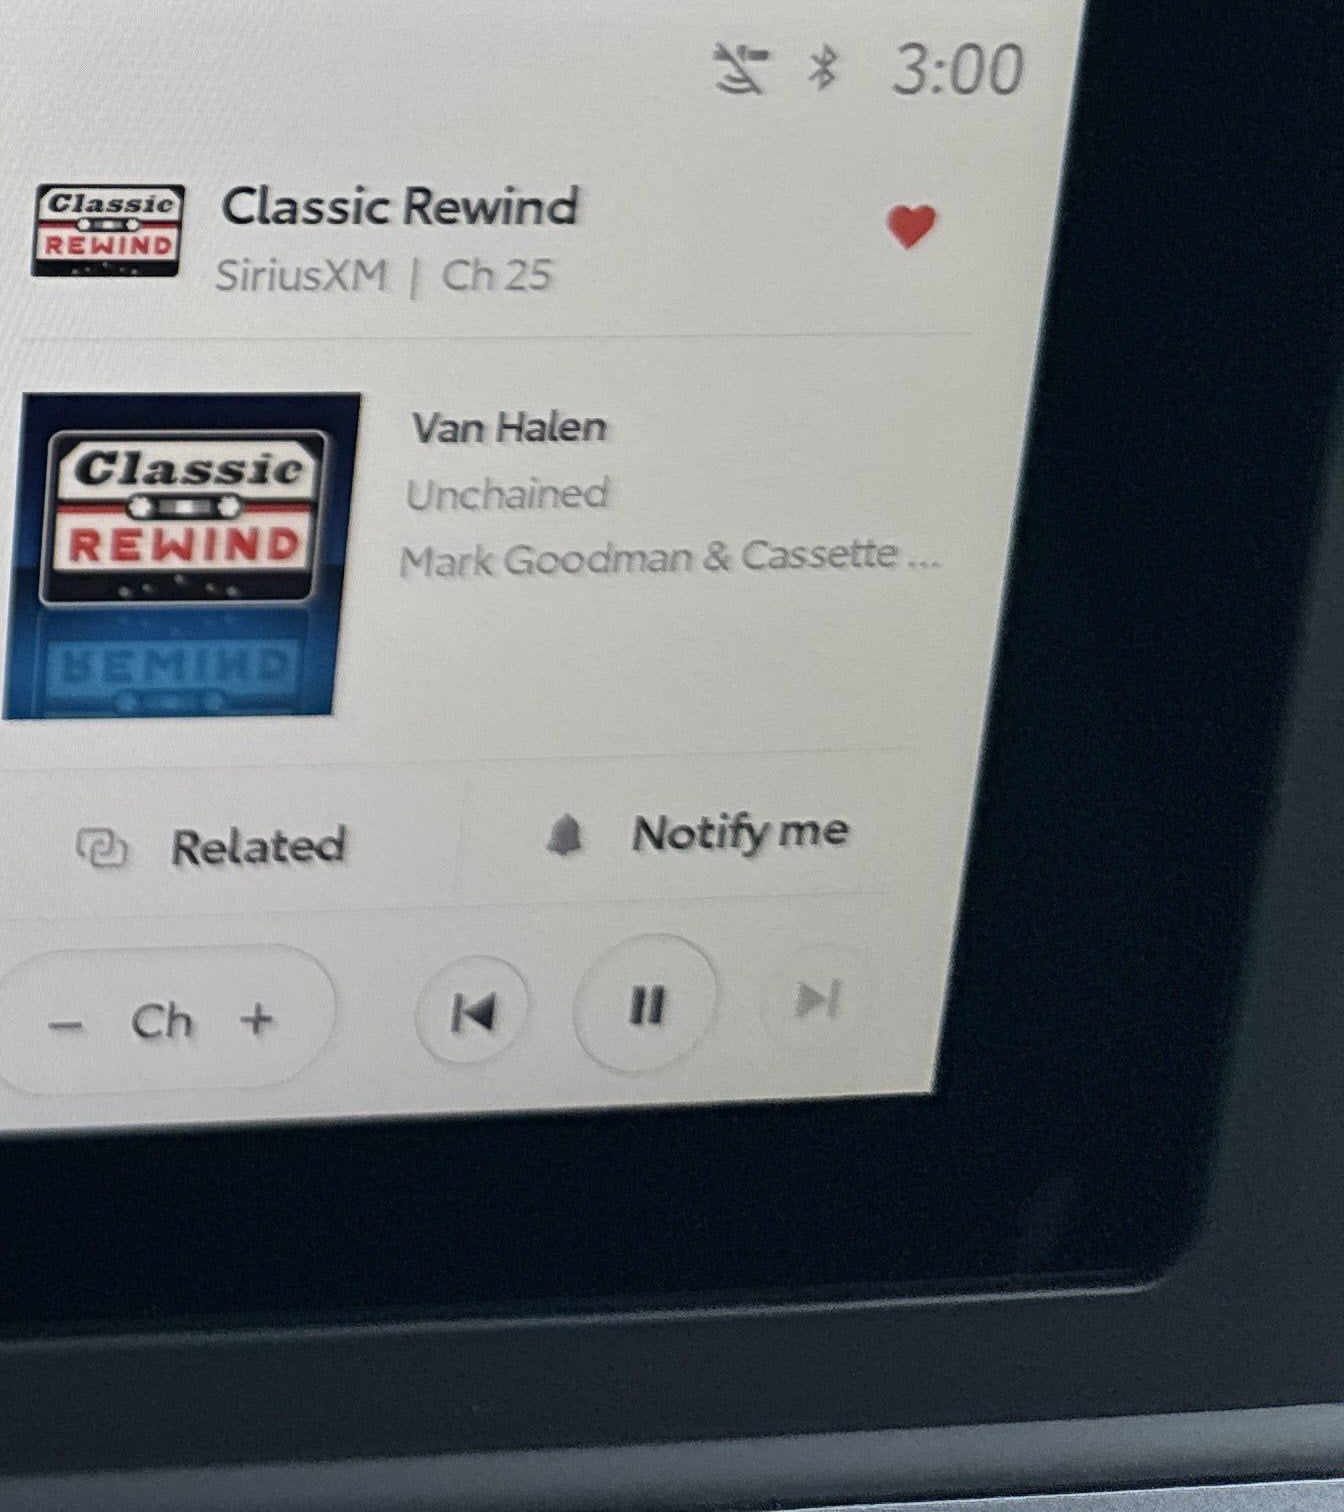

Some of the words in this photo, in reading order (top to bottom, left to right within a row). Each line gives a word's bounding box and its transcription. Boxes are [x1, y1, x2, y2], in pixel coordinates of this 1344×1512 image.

[893, 42, 1025, 96] 3:00
[46, 191, 178, 213] Classic
[223, 185, 390, 225] Classic
[404, 185, 579, 225] Rewind
[46, 232, 172, 255] REWIND
[216, 258, 389, 292] SiriusXM
[442, 258, 496, 292] Ch
[505, 258, 553, 292] 25
[414, 413, 486, 444] Van
[497, 410, 608, 443] Halen
[73, 449, 305, 486] Classic
[407, 475, 612, 512] Unchained
[70, 527, 301, 562] REWIND
[401, 545, 495, 578] Mark
[504, 542, 696, 576] Goodman
[703, 540, 732, 574] &
[742, 539, 900, 571] Cassette
[173, 825, 347, 866] Related
[633, 812, 772, 859] Notify
[780, 820, 850, 846] me
[132, 1002, 193, 1041] Ch
